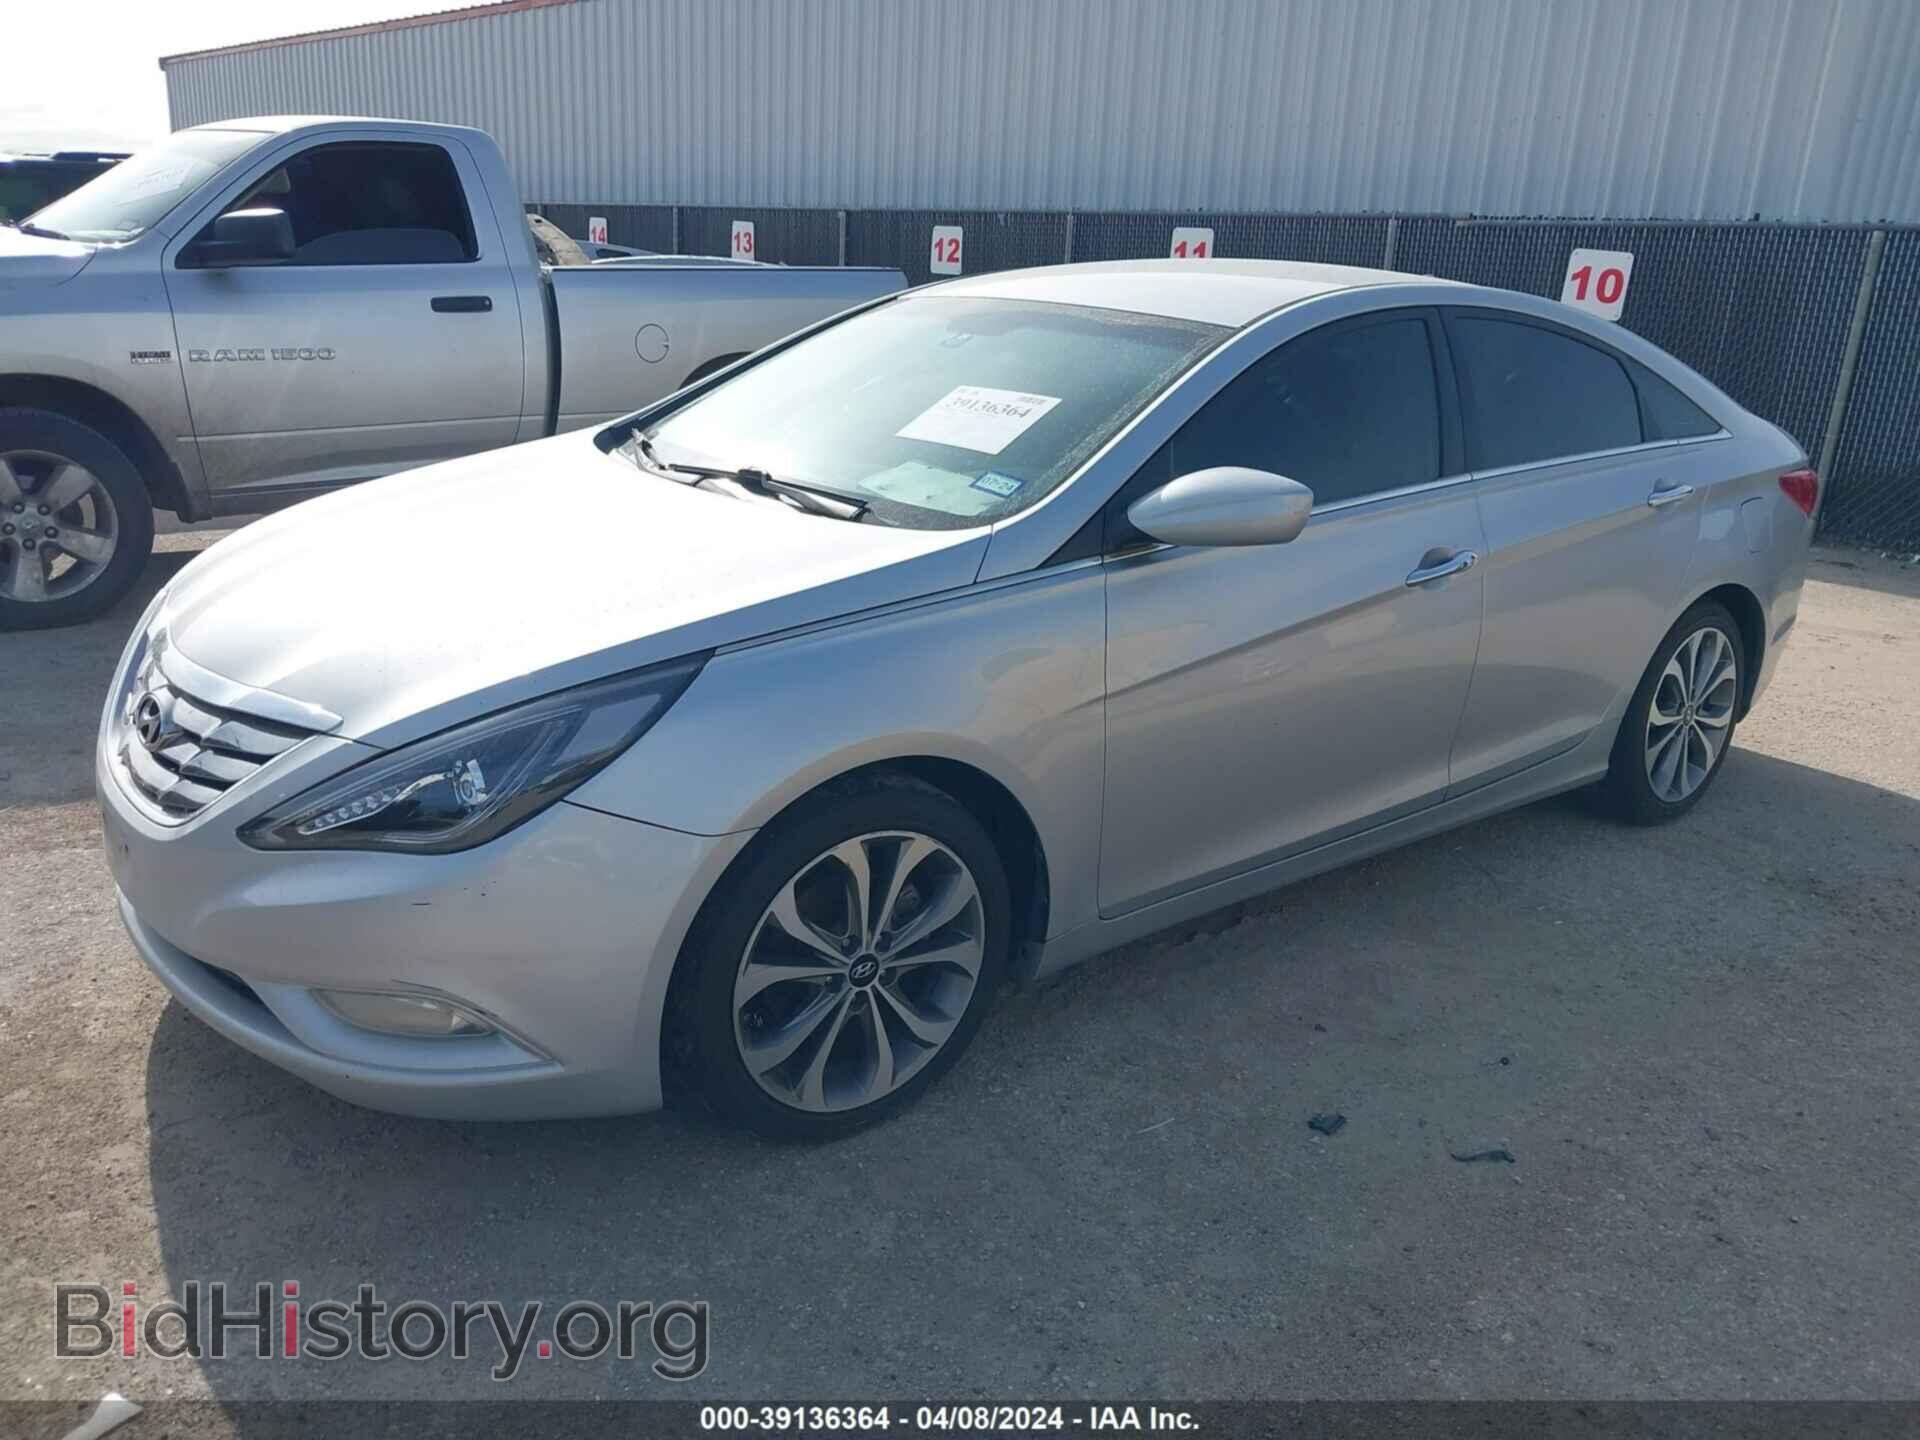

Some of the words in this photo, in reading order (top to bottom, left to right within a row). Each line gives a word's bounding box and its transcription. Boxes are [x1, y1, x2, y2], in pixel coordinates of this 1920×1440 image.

[591, 225, 605, 243] 14
[734, 231, 752, 253] 13
[934, 238, 960, 263] 12
[1570, 265, 1624, 304] 10
[188, 348, 265, 362] RAM
[271, 348, 336, 360] 1500
[945, 395, 1034, 418] 39136364
